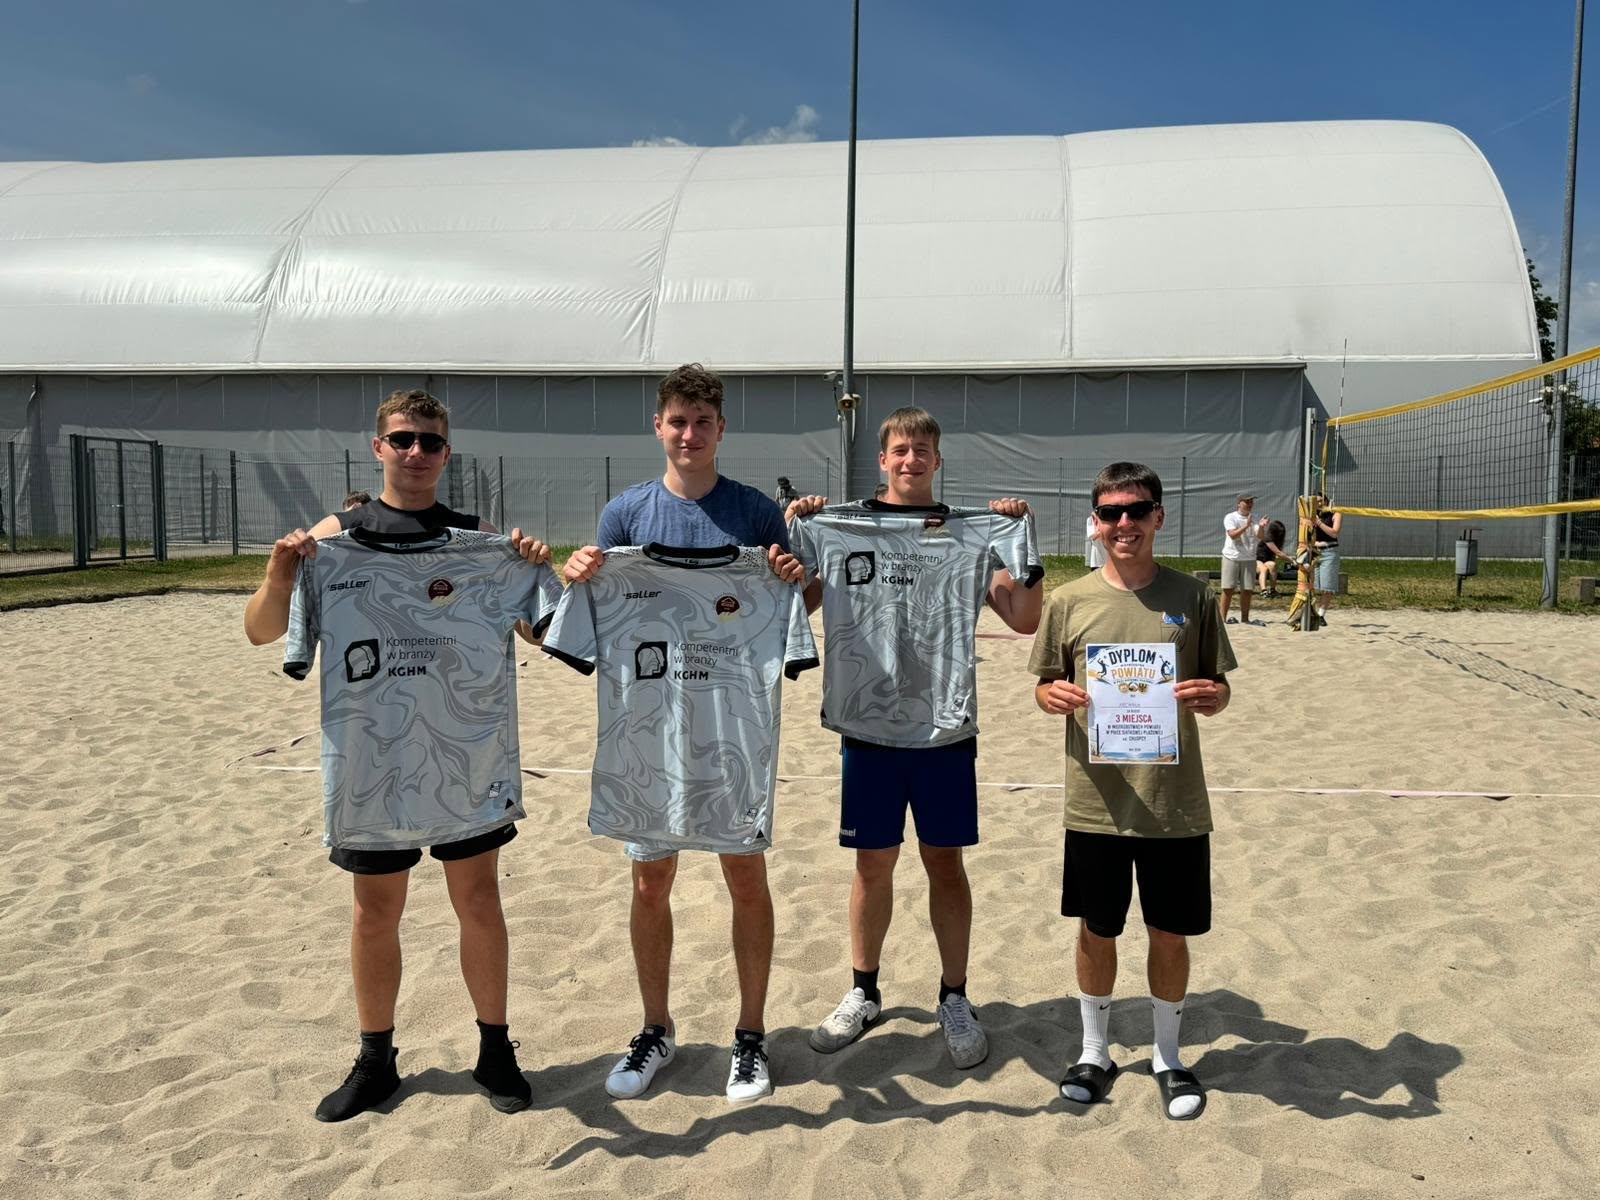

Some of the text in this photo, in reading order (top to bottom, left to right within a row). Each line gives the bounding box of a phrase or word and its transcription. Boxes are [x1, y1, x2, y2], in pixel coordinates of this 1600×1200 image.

[881, 551, 943, 564] Kompetentni
[328, 580, 370, 592] saller
[881, 576, 914, 586] KGHM
[624, 590, 662, 600] saller
[386, 635, 457, 648] Kompetentni
[674, 641, 738, 656] Kompetentni
[386, 649, 436, 662] w branży
[674, 654, 718, 668] w branży
[1108, 648, 1157, 665] DYPLOM
[388, 666, 427, 677] KGHM
[674, 671, 709, 681] KGHM
[1111, 667, 1157, 679] POWIATU
[1115, 714, 1153, 723] 3 MIEJSCA
